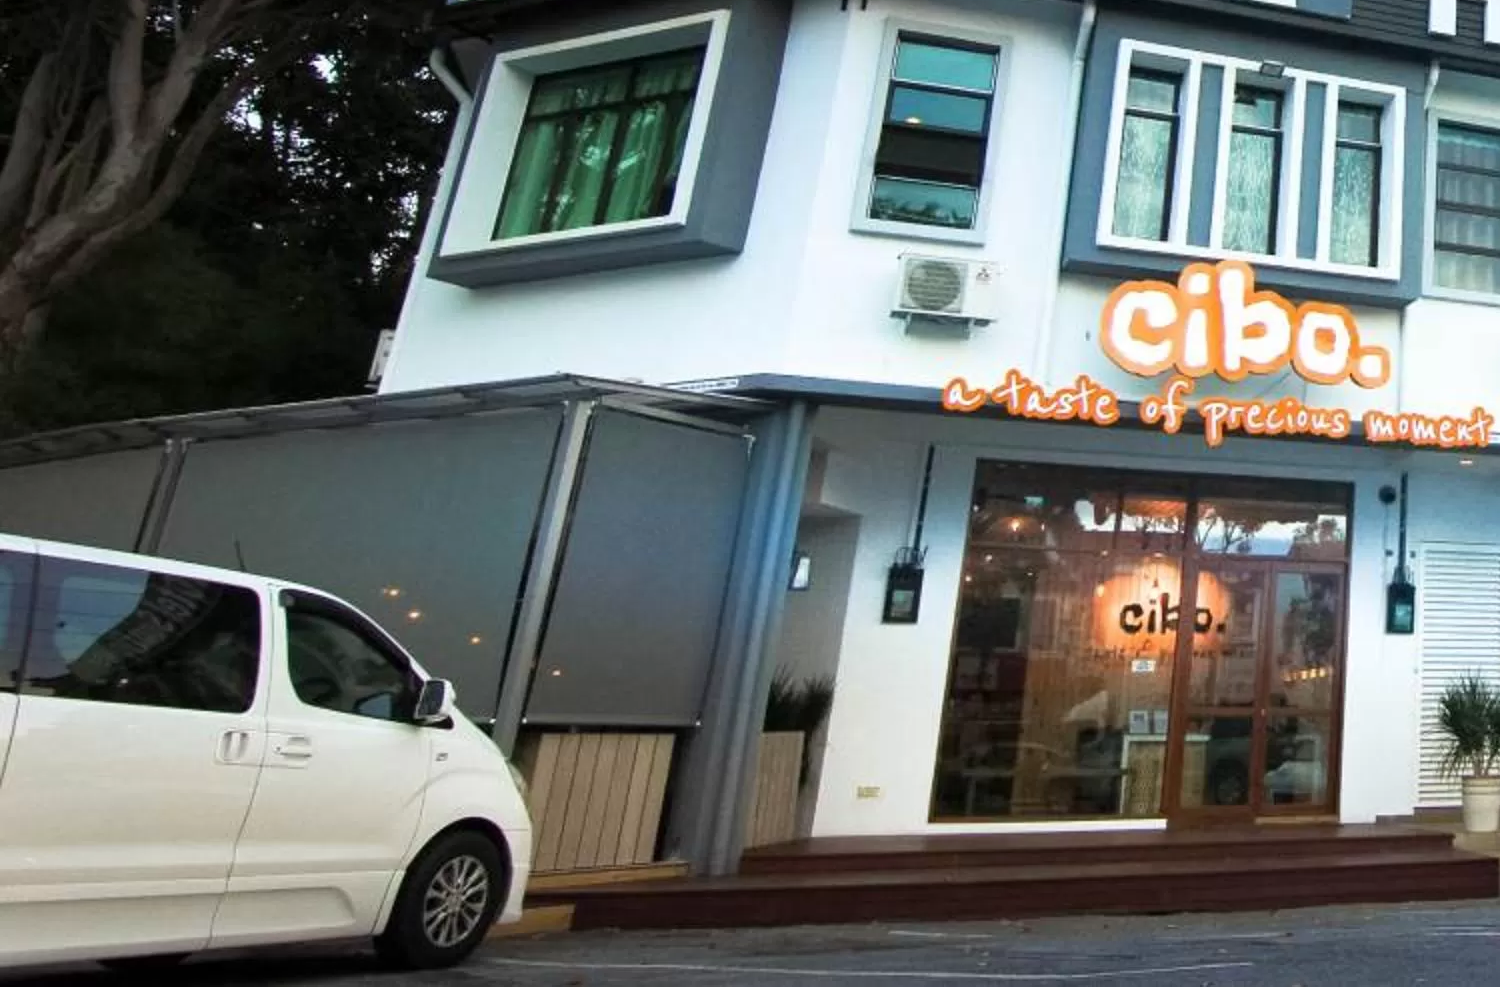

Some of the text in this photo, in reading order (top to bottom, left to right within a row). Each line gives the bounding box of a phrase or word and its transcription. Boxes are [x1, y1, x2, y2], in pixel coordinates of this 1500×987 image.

[1104, 264, 1387, 383] cibo.
[945, 372, 1492, 444] a taste of precious moment
